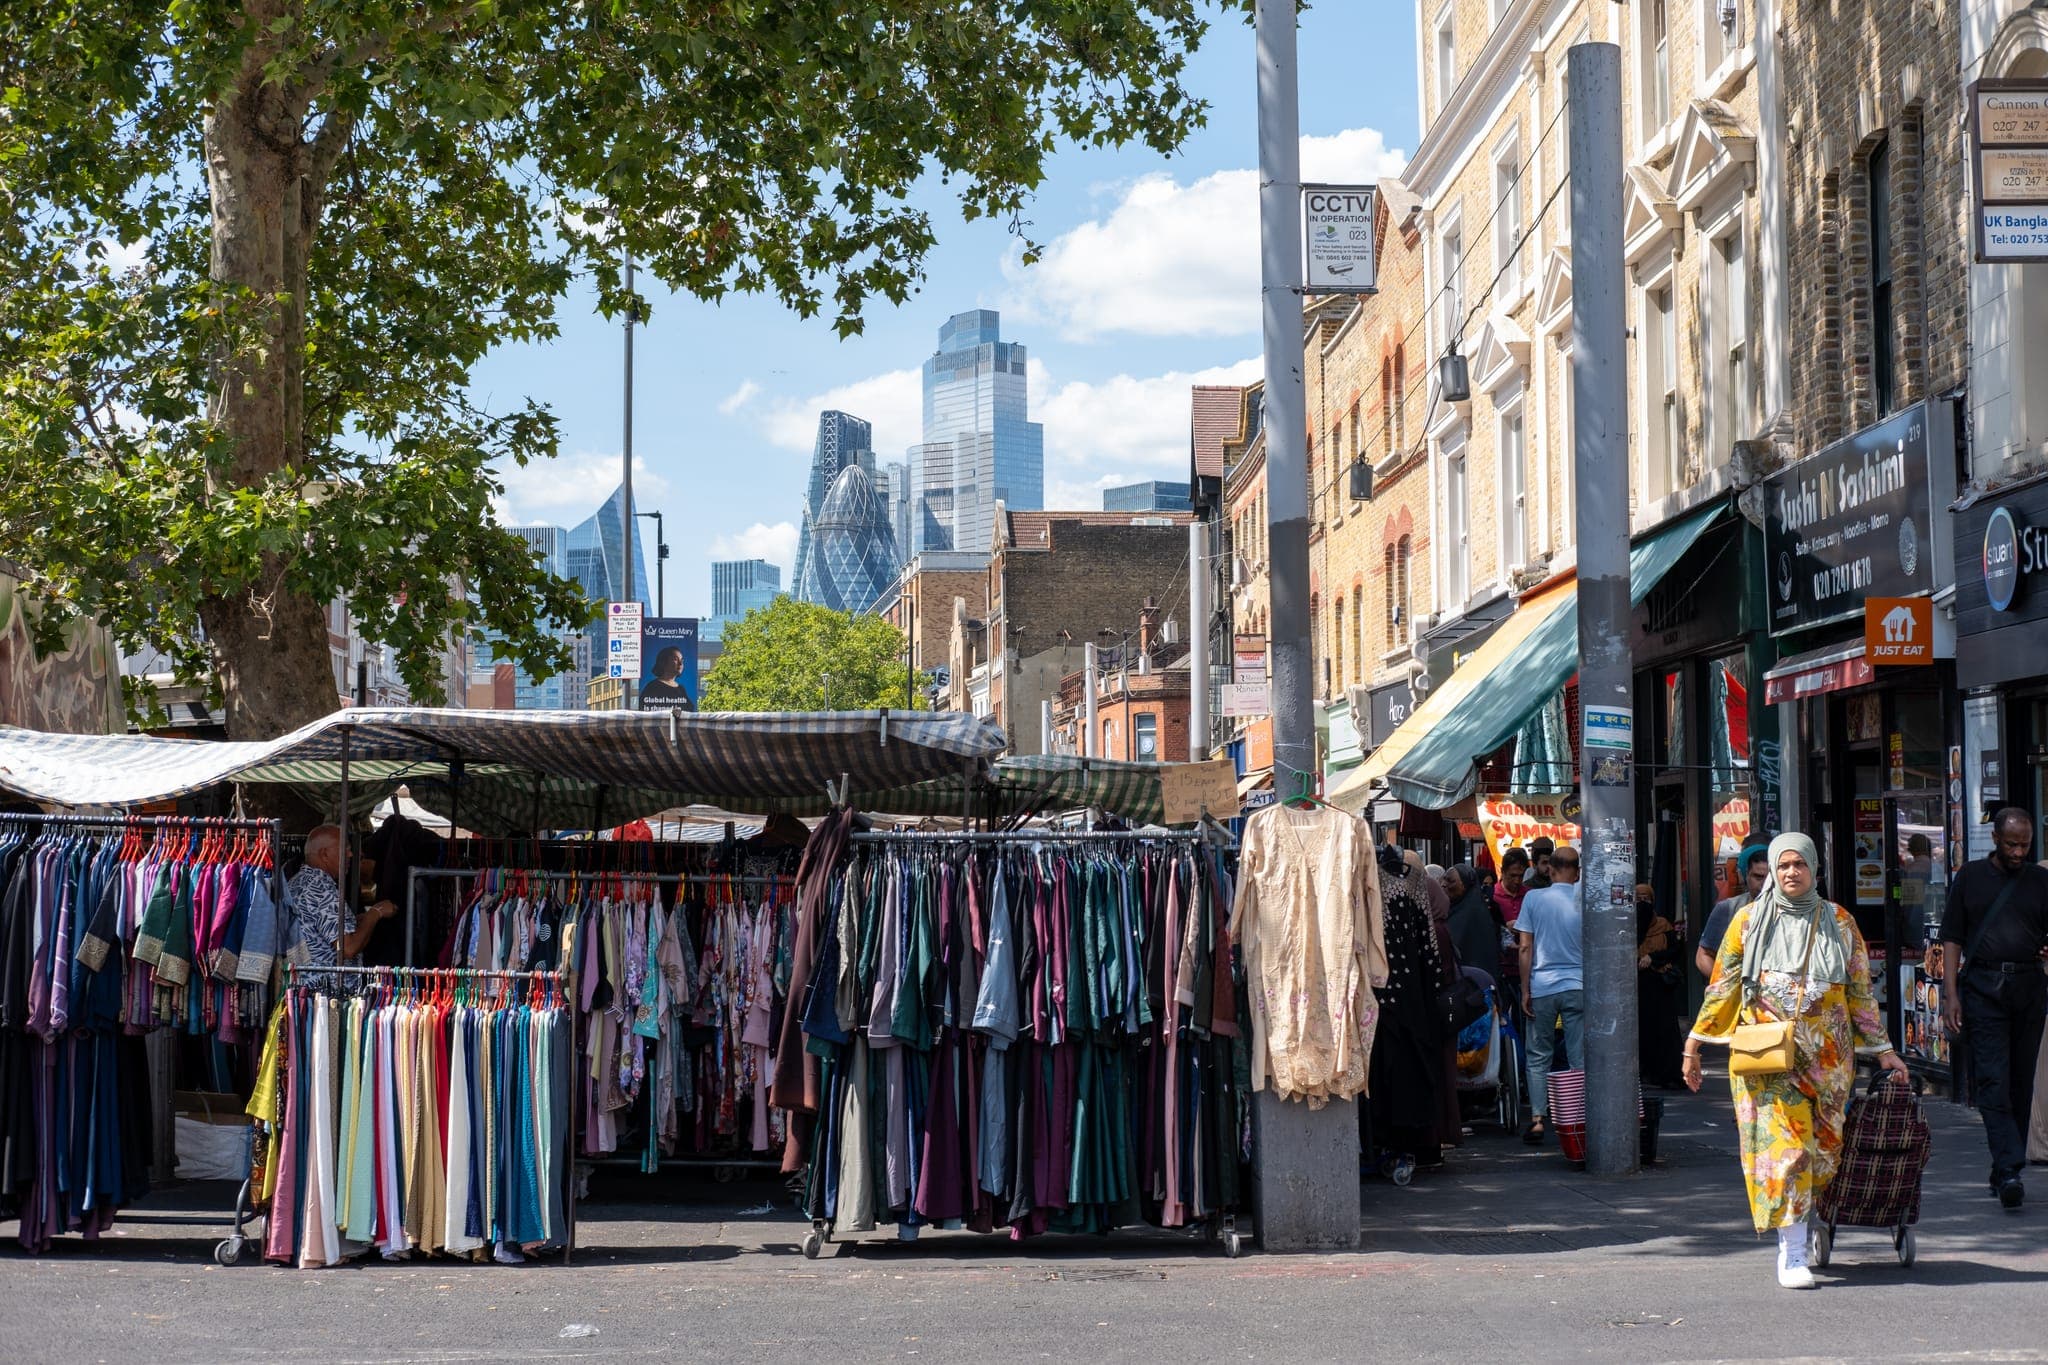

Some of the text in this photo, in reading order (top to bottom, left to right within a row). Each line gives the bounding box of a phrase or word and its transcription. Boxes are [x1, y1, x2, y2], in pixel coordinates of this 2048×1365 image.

[1986, 97, 2038, 110] Cannon
[1992, 120, 2017, 132] 0207
[2022, 120, 2040, 132] 247
[2002, 177, 2020, 186] 020
[2025, 177, 2041, 186] 247
[1310, 195, 1369, 212] CCTV
[1985, 215, 2048, 230] UK Bangla
[1349, 230, 1367, 240] 023
[1992, 234, 2048, 244] Tel: 020 753
[1908, 424, 1921, 442] 219
[1780, 438, 1905, 535] Sushi N Sashimi
[1827, 532, 1840, 547] curry
[1844, 521, 1867, 540] Noodles
[1871, 513, 1889, 530] Momo
[1988, 539, 2013, 565] stuart
[1814, 570, 1830, 600] 020
[1851, 556, 1872, 589] 1678
[679, 628, 693, 636] Mary
[1873, 645, 1924, 656] JUST EAT
[1498, 804, 1554, 816] MAHIR
